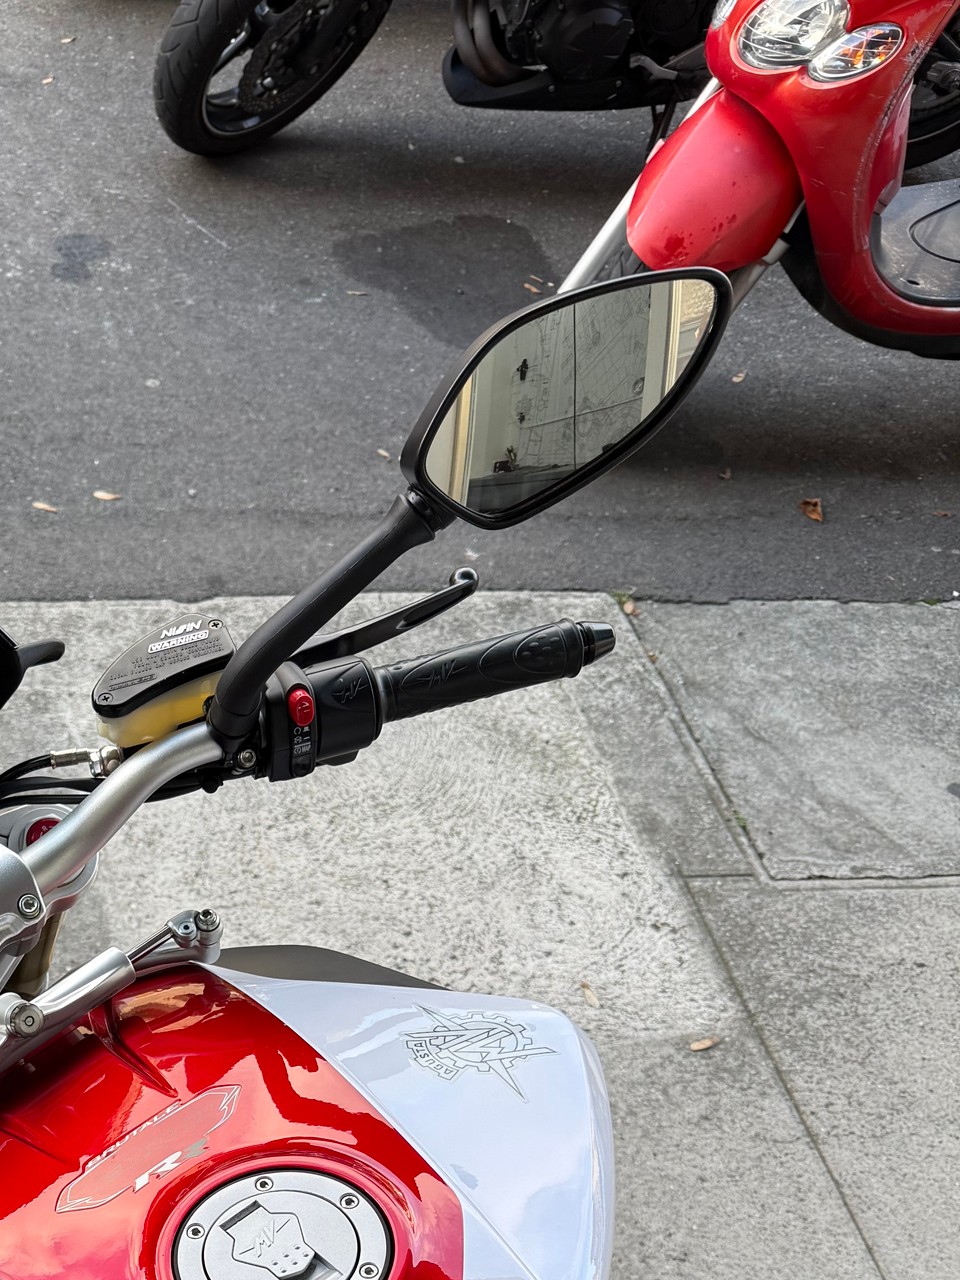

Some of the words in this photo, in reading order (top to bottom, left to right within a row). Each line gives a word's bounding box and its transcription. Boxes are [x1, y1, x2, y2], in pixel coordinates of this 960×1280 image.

[149, 630, 209, 652] WARNING
[417, 1042, 454, 1075] AGUSTA
[86, 1101, 180, 1168] BRUTALE
